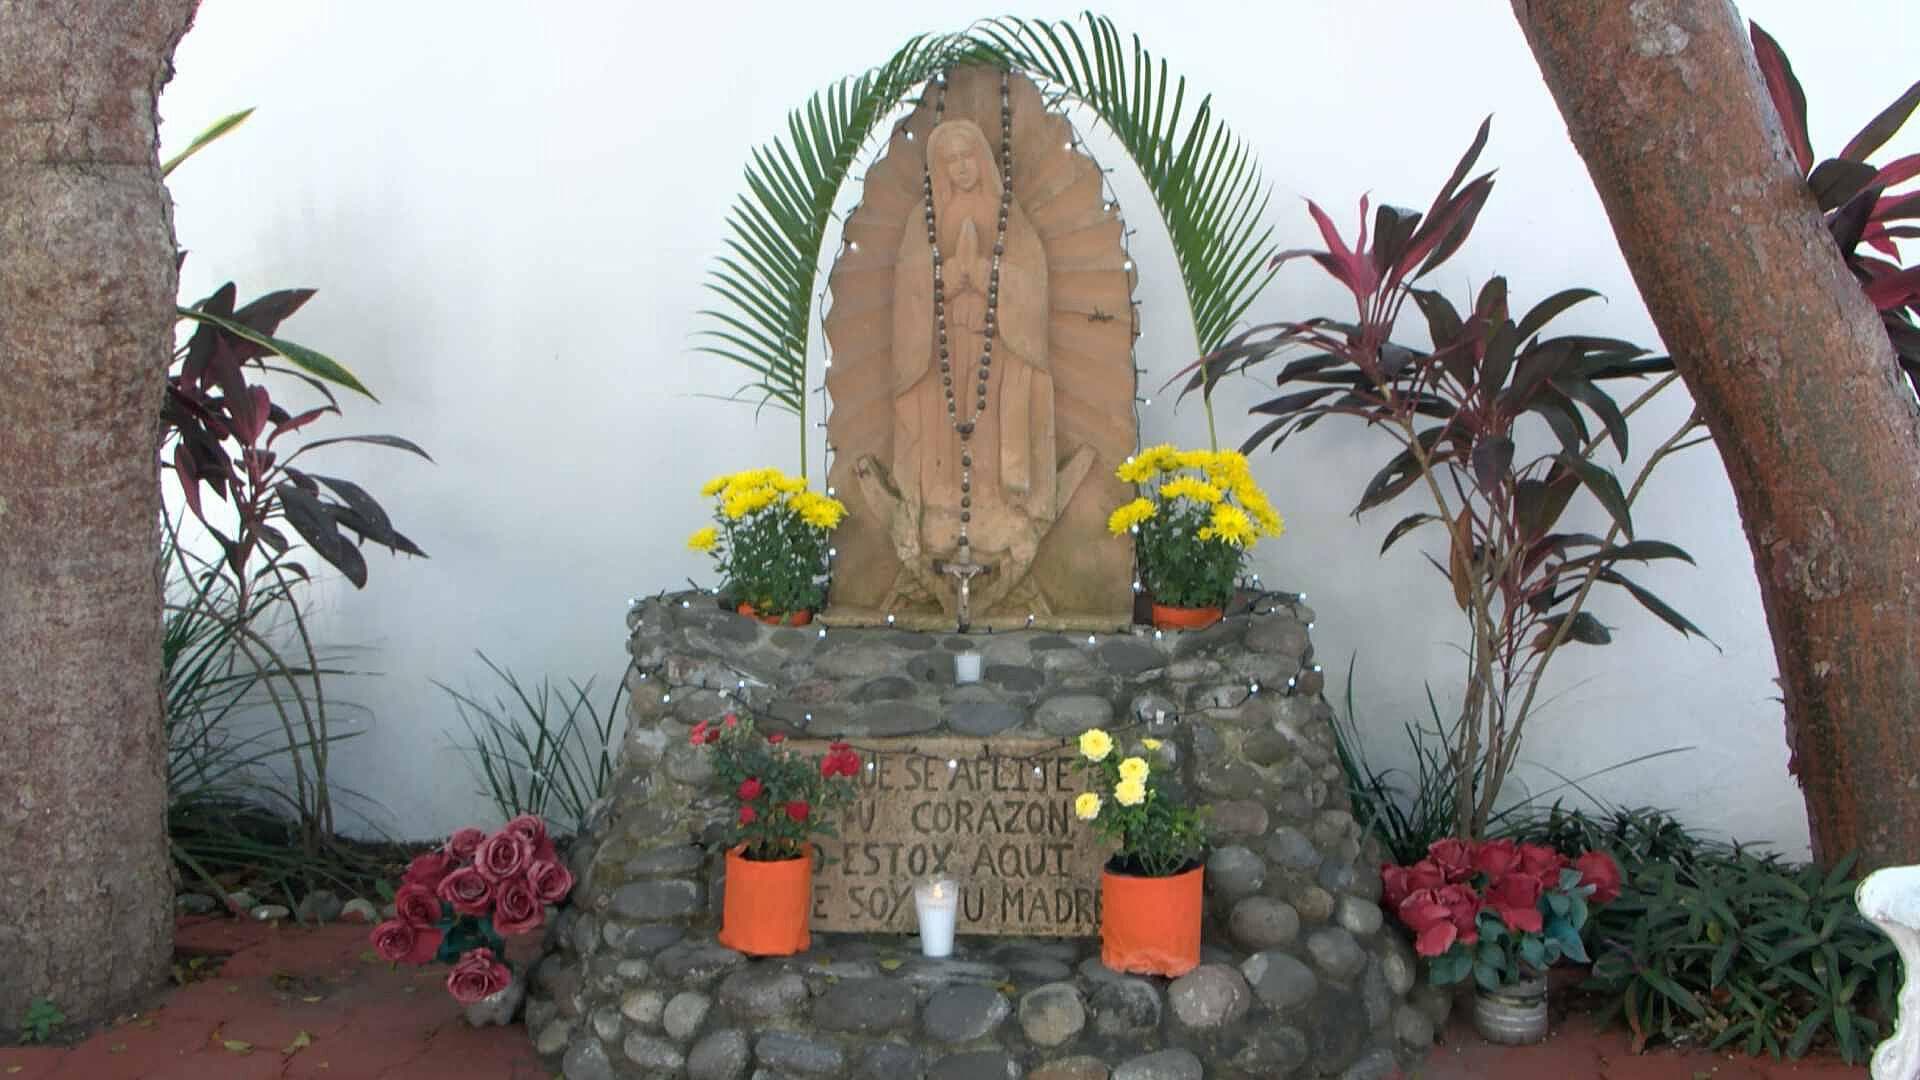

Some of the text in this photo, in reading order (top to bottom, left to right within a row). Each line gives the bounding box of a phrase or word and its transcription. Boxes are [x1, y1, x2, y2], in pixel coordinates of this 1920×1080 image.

[860, 752, 1074, 792] UE SE AFLIJE
[971, 843, 1073, 878] AQUI
[848, 880, 912, 927] SOY
